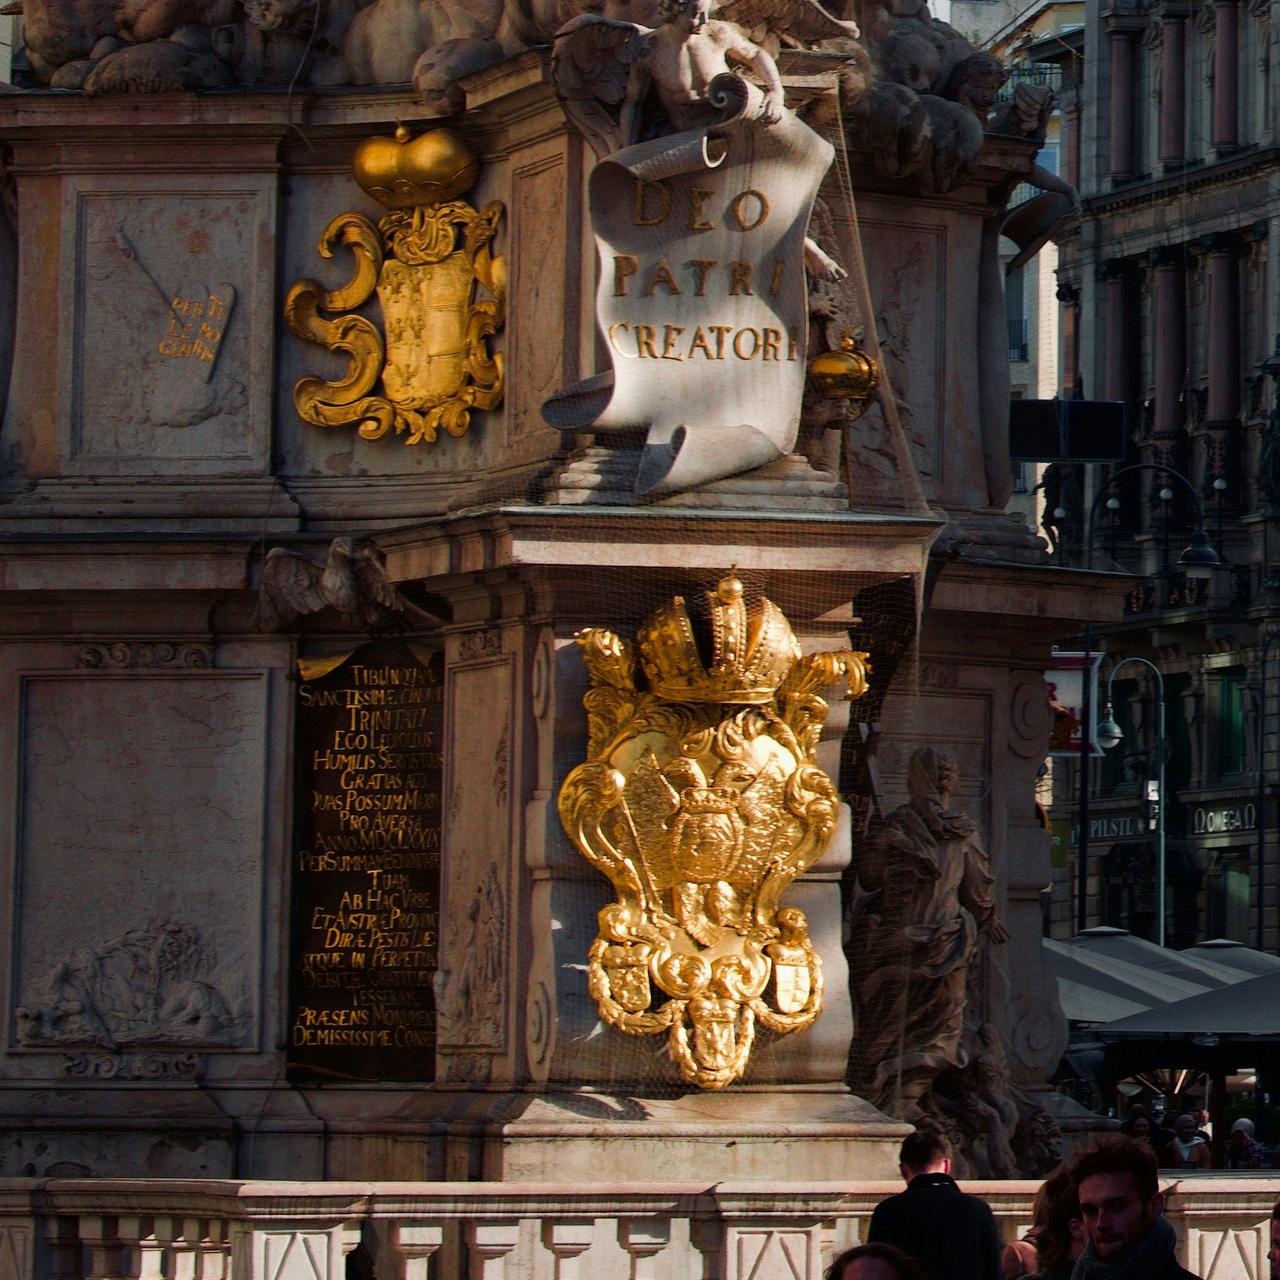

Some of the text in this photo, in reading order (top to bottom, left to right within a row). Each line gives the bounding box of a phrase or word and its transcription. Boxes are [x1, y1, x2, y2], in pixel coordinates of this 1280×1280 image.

[631, 180, 767, 230] DEO
[613, 254, 785, 295] PATRI
[608, 320, 800, 360] CREATORI
[1207, 809, 1242, 833] OMEGA
[339, 889, 363, 910] AB
[350, 950, 365, 968] IN
